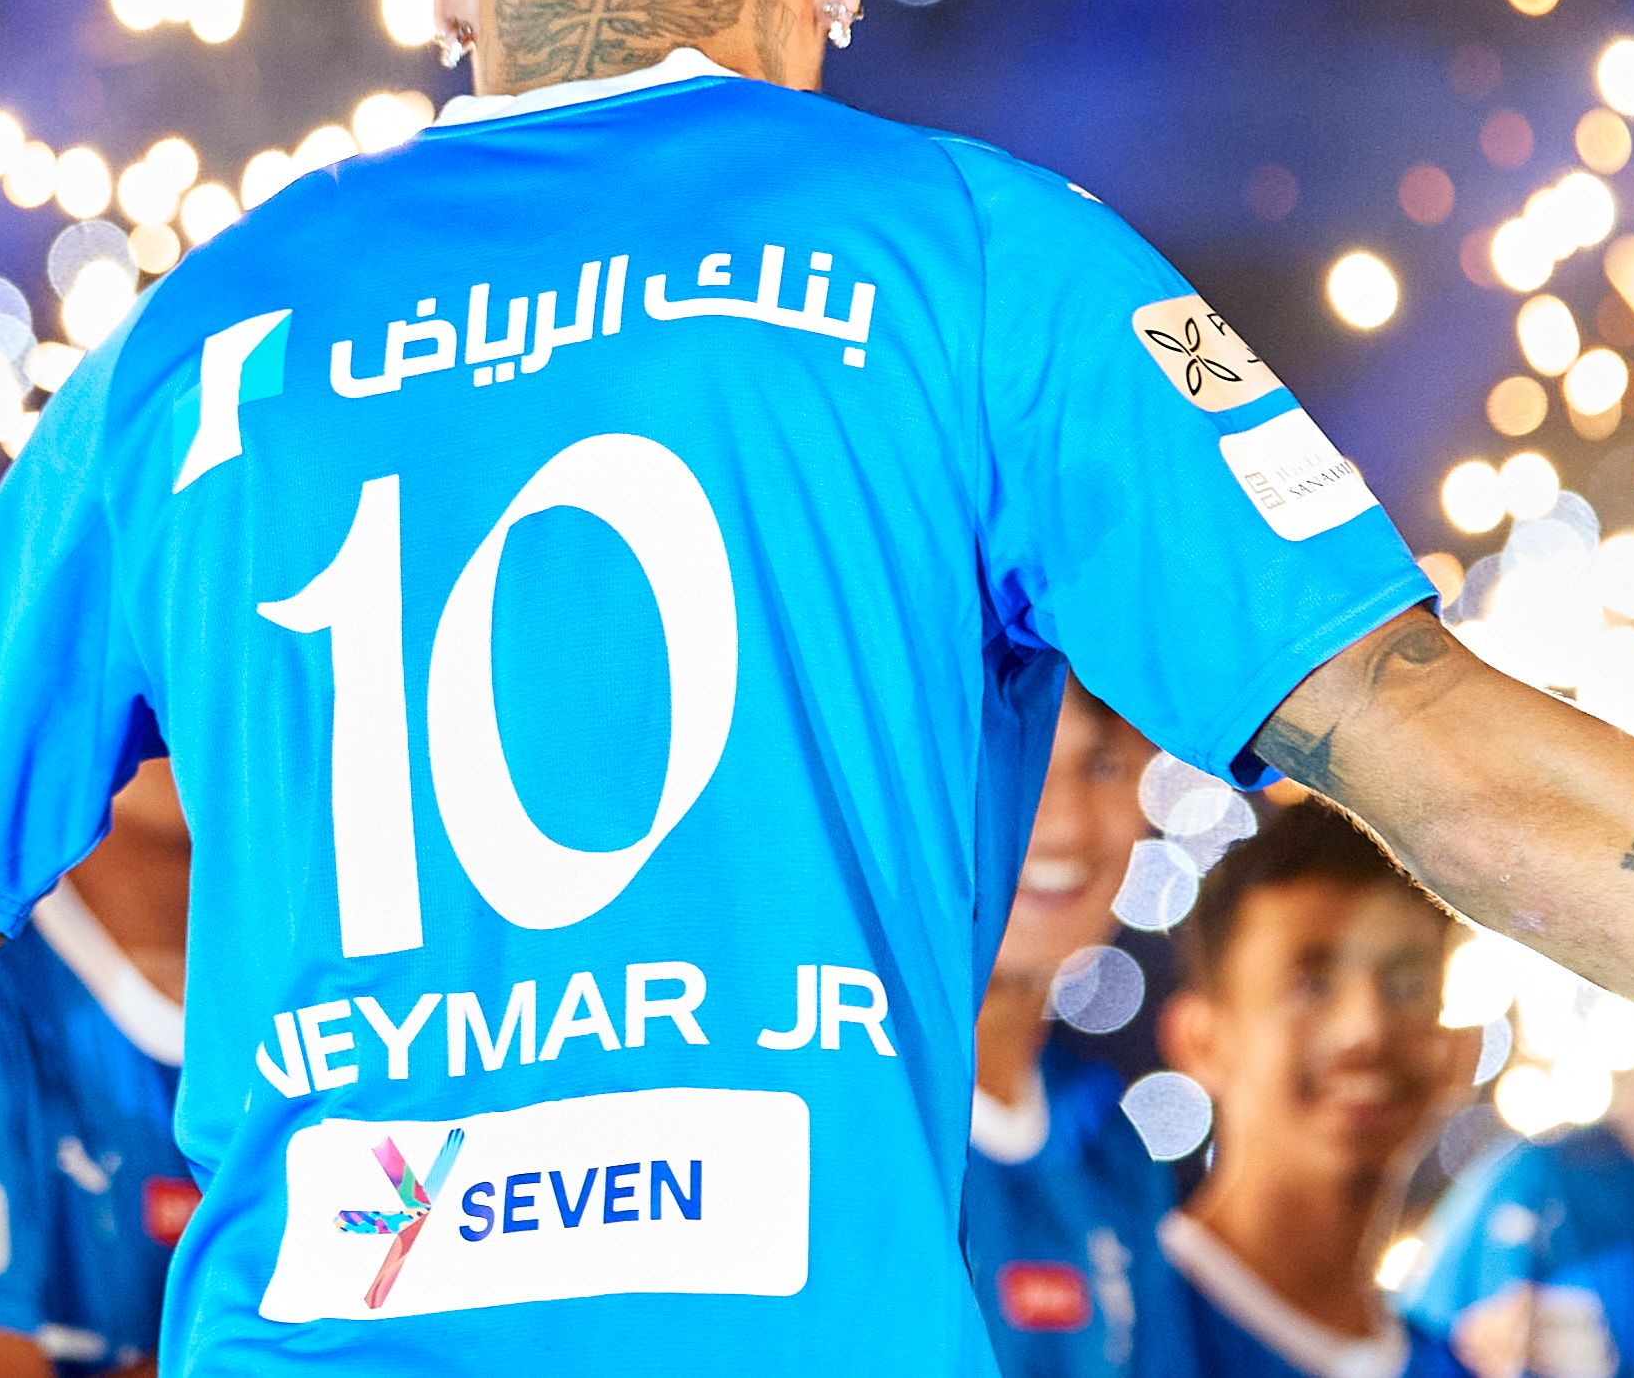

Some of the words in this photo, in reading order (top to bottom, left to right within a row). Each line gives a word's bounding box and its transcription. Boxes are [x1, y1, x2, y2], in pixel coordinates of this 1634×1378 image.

[330, 254, 629, 399] الرياض
[644, 244, 876, 369] بنك
[256, 433, 739, 959] 10
[756, 964, 897, 1057] JR
[458, 1159, 703, 1243] SEVEN
